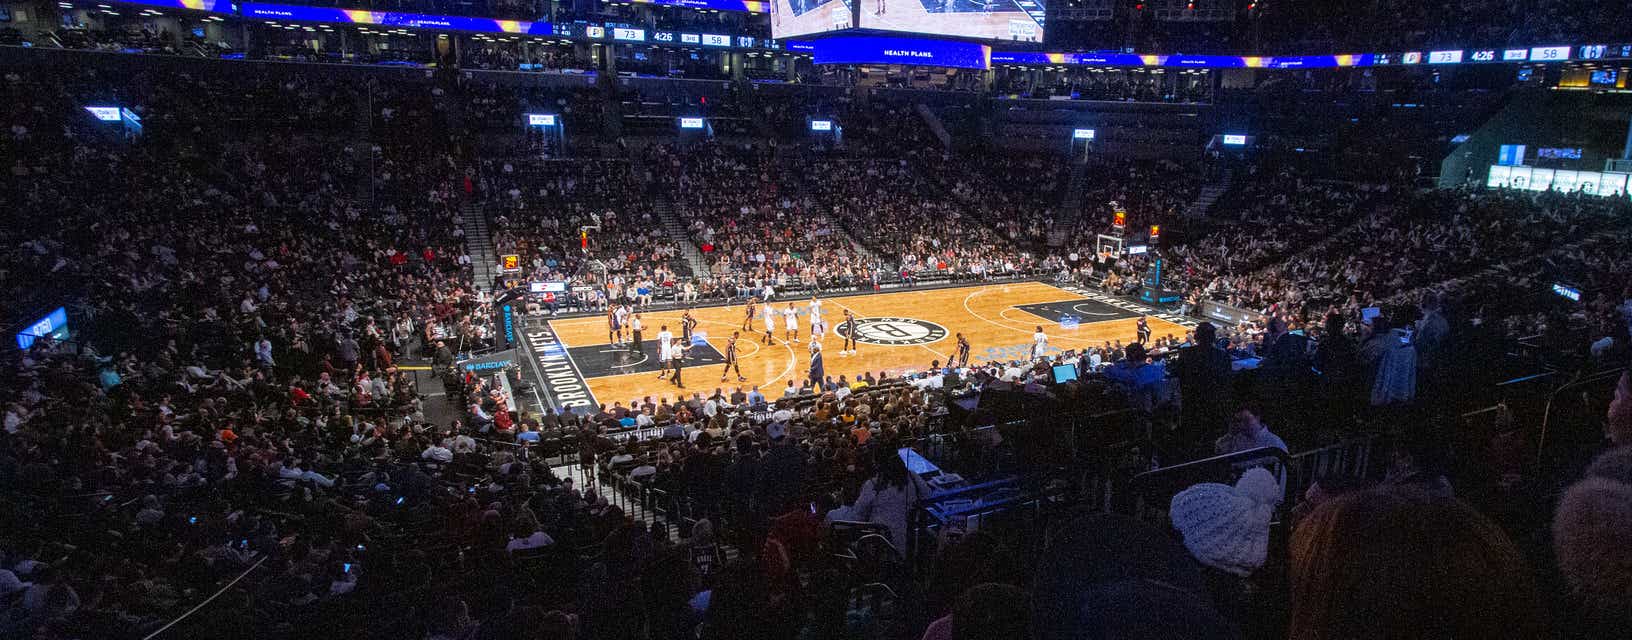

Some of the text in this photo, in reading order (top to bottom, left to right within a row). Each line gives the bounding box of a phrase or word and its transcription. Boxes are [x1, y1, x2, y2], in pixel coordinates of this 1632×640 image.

[624, 30, 636, 39] 73
[653, 32, 673, 41] 4:26
[711, 36, 722, 44] 58
[1440, 53, 1453, 62] 73
[1471, 51, 1494, 60] 4:26
[1543, 49, 1558, 58] 58
[527, 331, 564, 352] NETS
[538, 353, 591, 409] BROOKLYN
